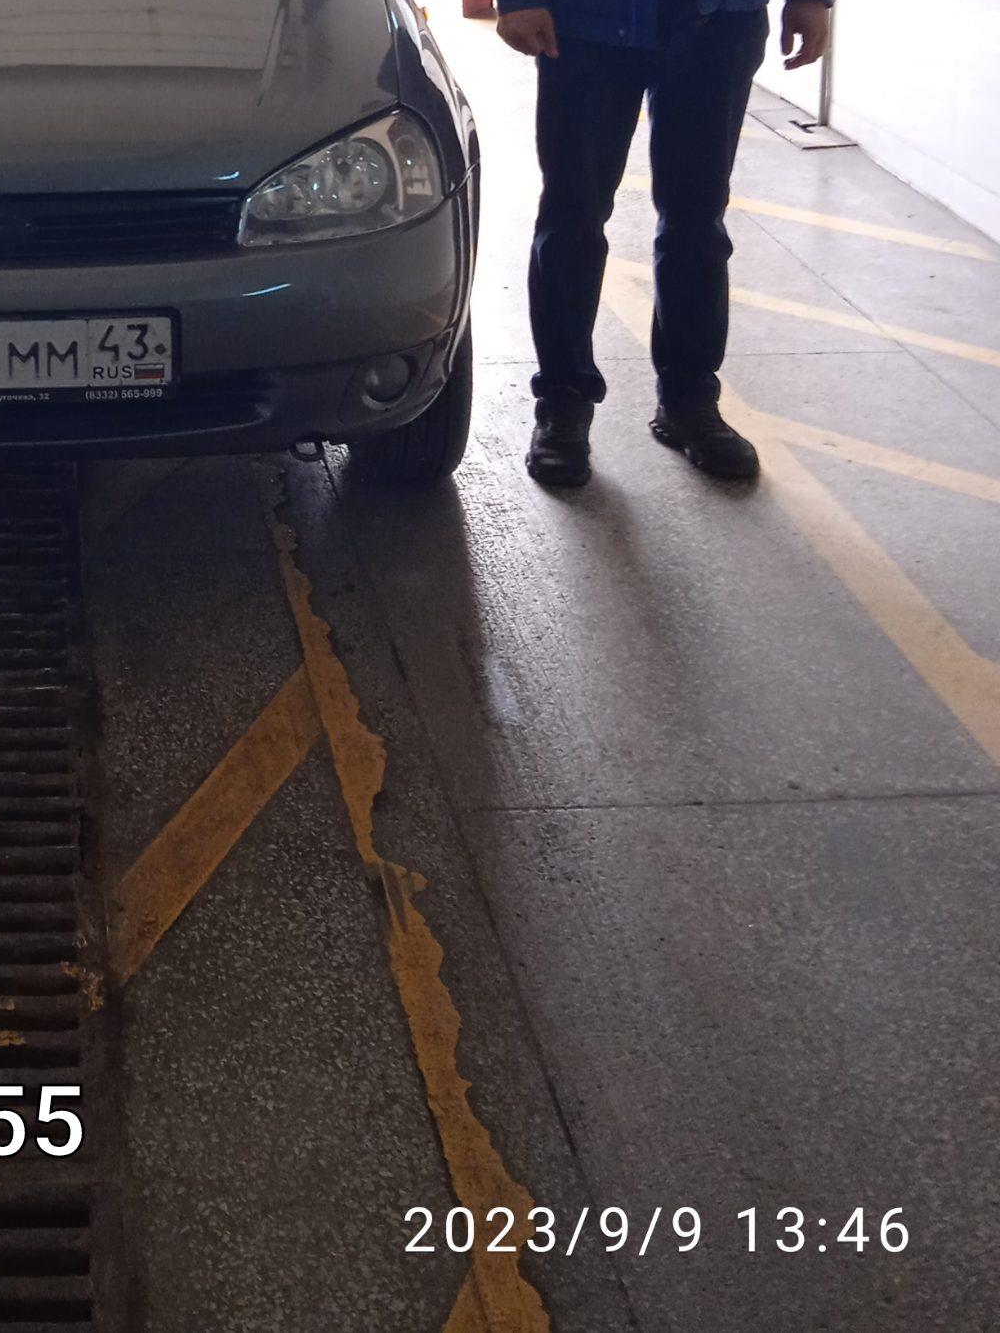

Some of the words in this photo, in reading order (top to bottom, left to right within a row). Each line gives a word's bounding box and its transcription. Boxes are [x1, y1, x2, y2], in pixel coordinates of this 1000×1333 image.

[98, 324, 149, 363] 43
[92, 365, 133, 380] RUS
[121, 388, 163, 399] 565-999
